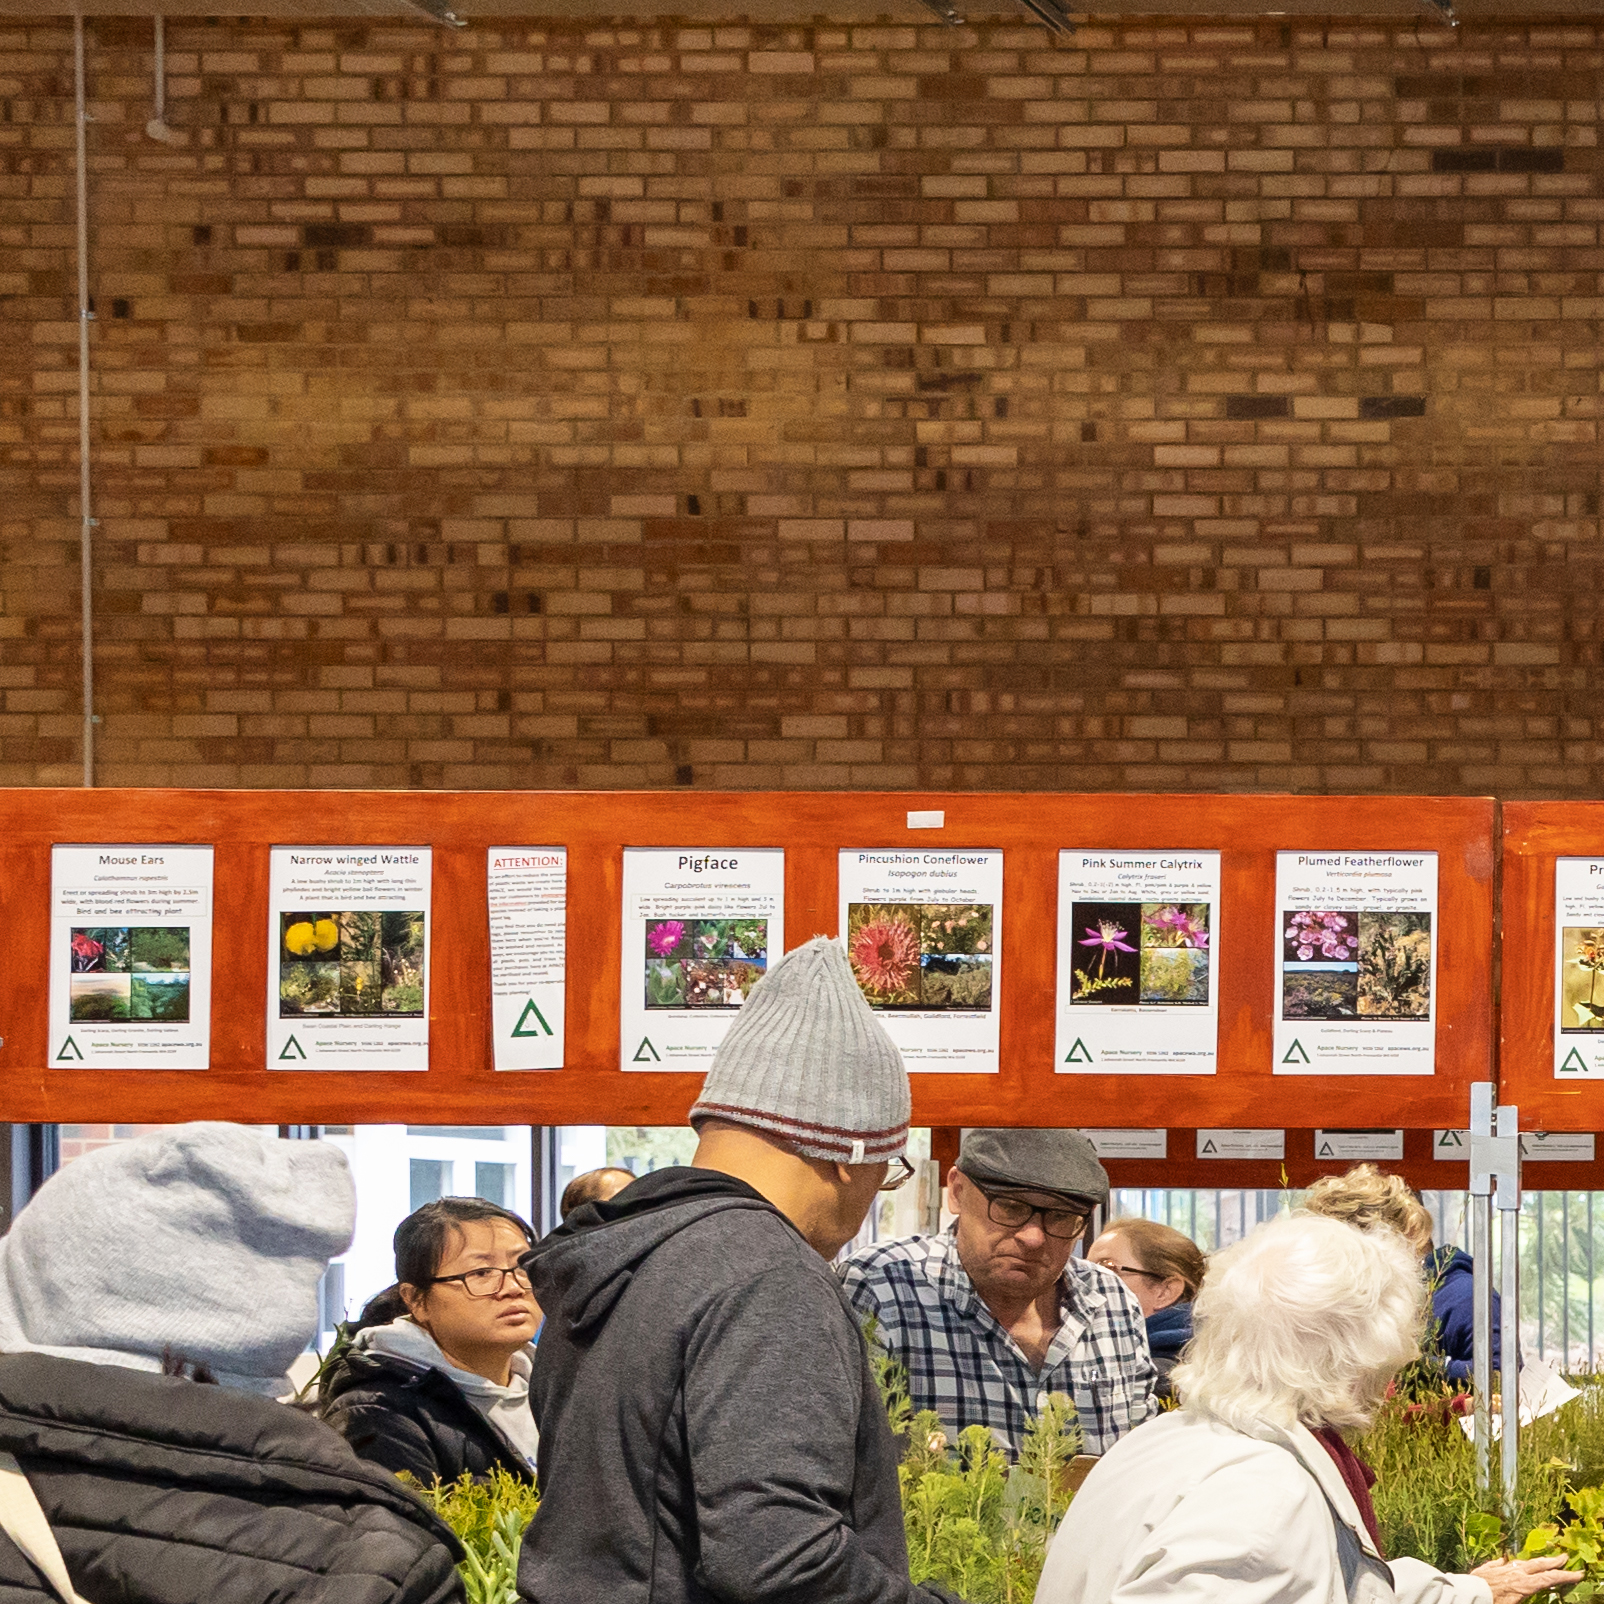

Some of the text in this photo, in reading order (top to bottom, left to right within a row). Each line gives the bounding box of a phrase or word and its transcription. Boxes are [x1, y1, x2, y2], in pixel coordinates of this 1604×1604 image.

[99, 855, 165, 865] Mouse Ears
[290, 854, 419, 867] Narrow winged Wattle
[493, 856, 564, 868] ATTENTION:
[678, 855, 738, 873] Pigface
[858, 854, 989, 865] Pincushion Coneflower
[1082, 858, 1203, 871] Pink Summer Calytrix
[1298, 856, 1424, 867] Plumed Featherflower
